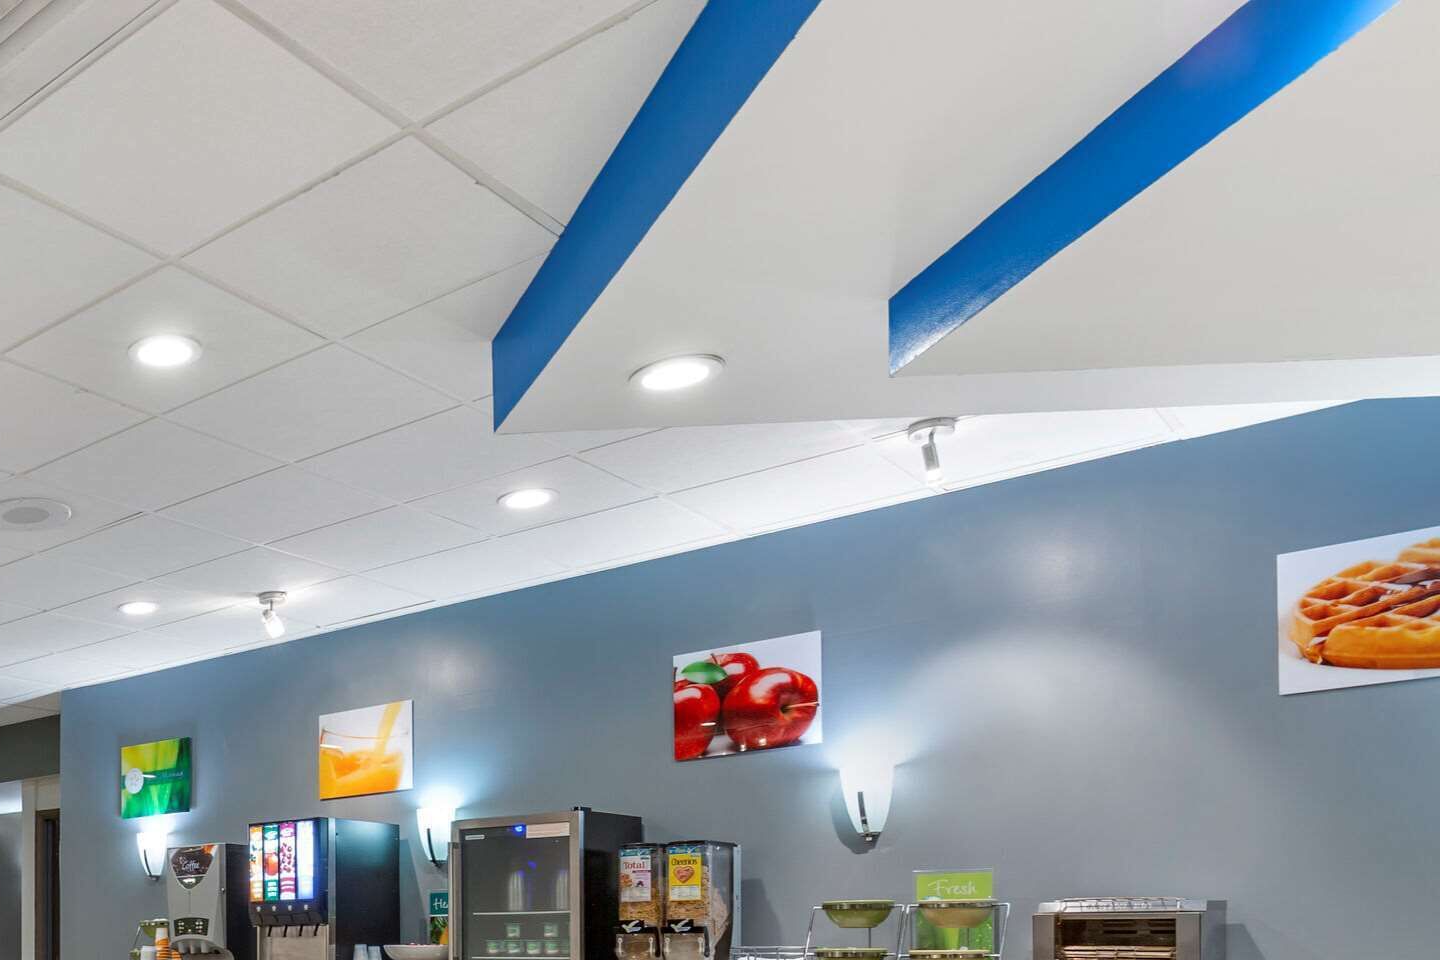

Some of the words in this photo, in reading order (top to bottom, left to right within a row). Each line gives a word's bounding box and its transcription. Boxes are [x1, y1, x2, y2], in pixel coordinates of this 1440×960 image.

[623, 861, 646, 869] Total
[927, 879, 978, 896] Fresh
[432, 897, 448, 910] He
